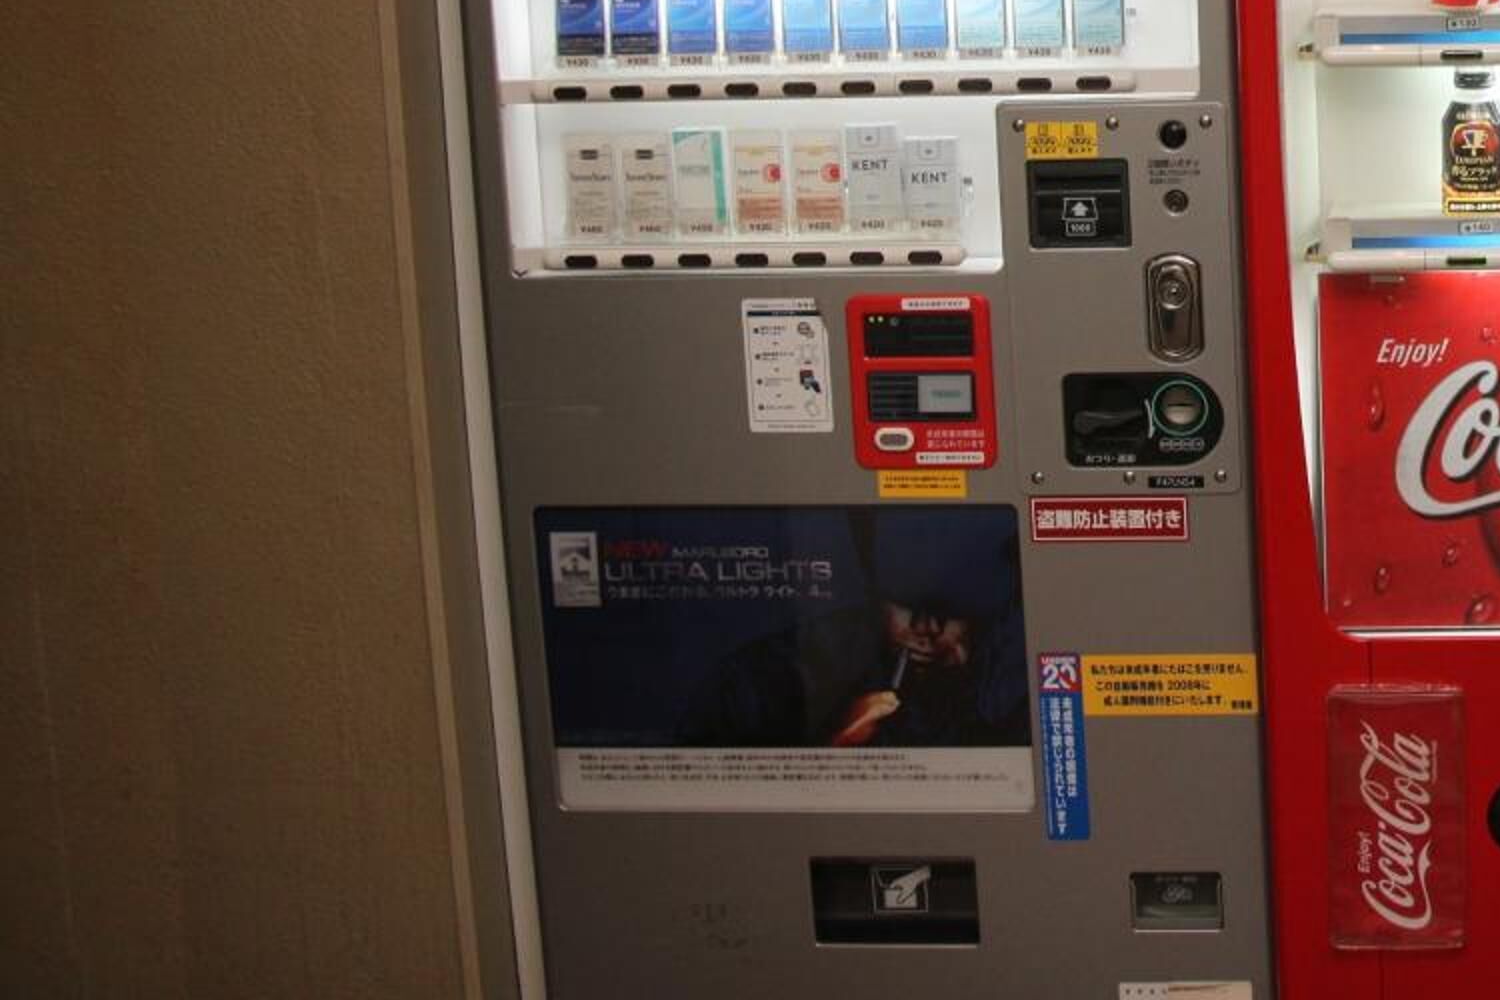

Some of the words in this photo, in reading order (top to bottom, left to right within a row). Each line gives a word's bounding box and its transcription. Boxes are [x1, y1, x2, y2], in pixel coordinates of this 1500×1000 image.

[851, 158, 889, 172] KENT
[910, 171, 948, 185] KENT
[1377, 337, 1449, 366] Enjoy!
[1036, 508, 1182, 530] 盗難防止装置付き
[604, 560, 710, 582] ULTRA
[716, 560, 833, 582] LIGHTS
[1360, 719, 1433, 931] Coca-Cola
[1357, 830, 1373, 874] Enjoy!
